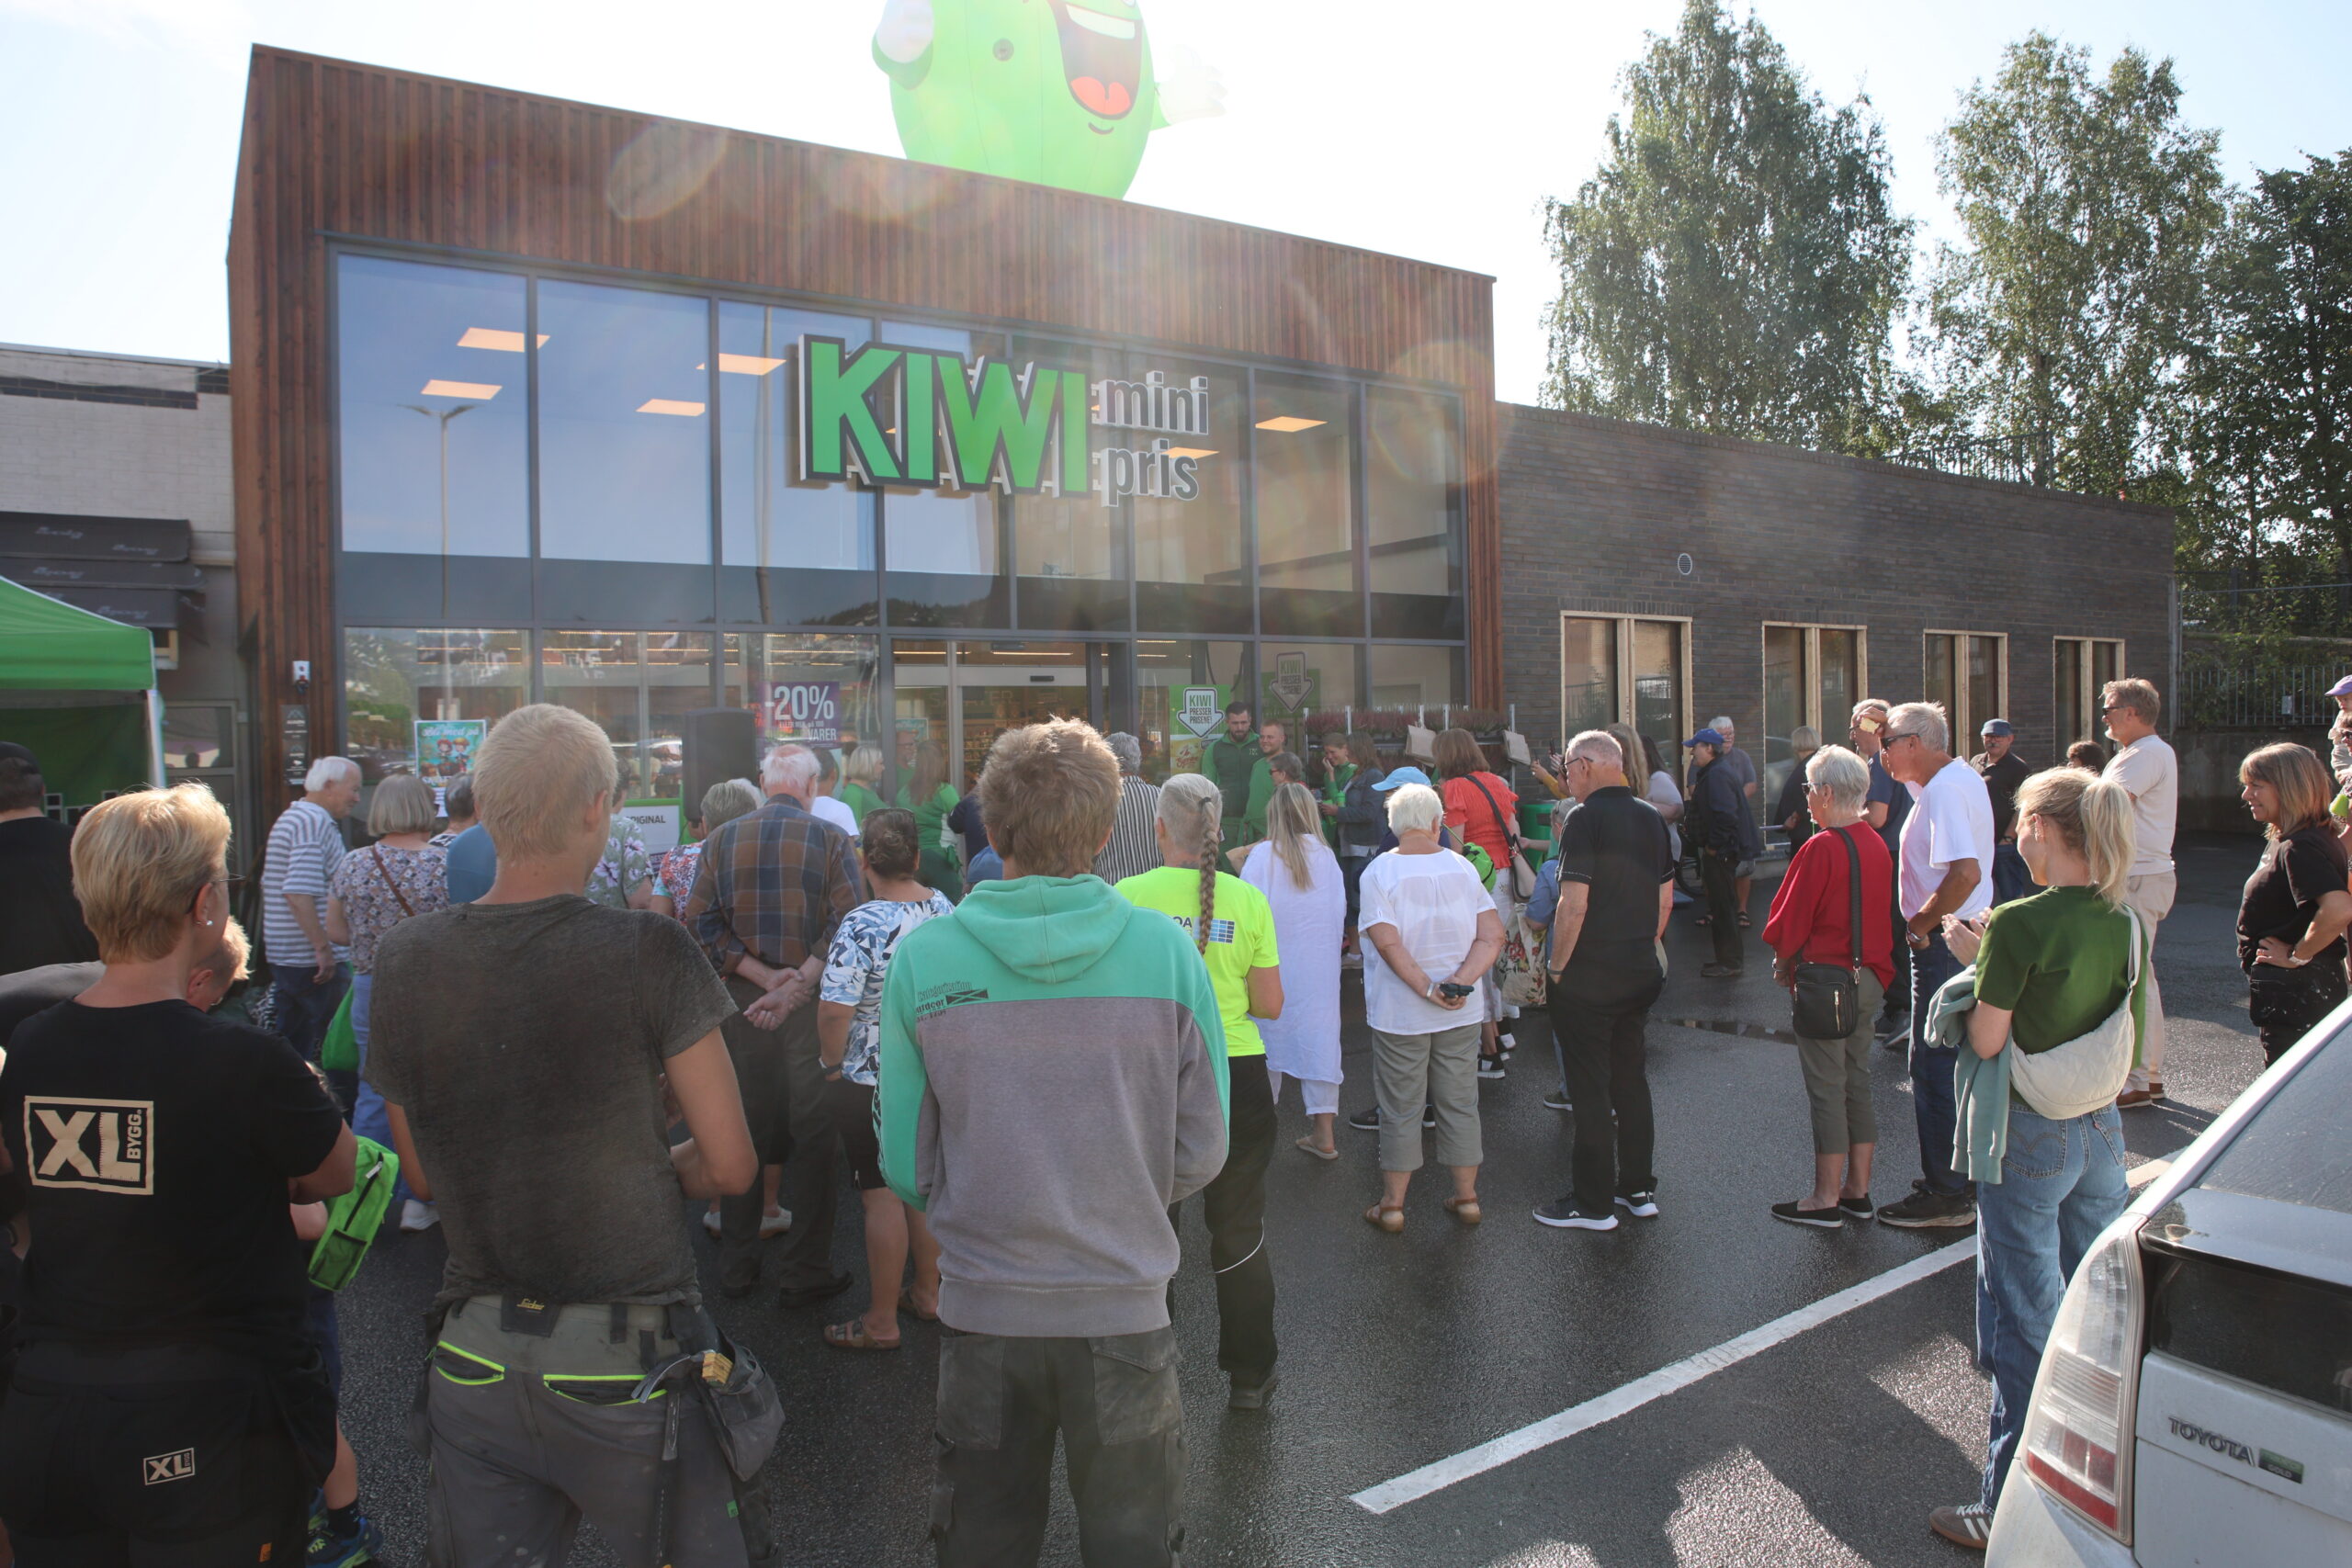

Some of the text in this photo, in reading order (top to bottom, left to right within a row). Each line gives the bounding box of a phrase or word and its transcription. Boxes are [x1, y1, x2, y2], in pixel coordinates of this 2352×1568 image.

[801, 333, 1092, 498] KIWI
[1101, 371, 1208, 434] mini
[1102, 438, 1199, 507] pris
[1281, 660, 1301, 674] KIWI
[764, 685, 834, 720] -20%
[1189, 694, 1212, 707] KIWI
[1189, 707, 1212, 716] PRESSER
[808, 728, 837, 740] VARER
[1189, 716, 1213, 724] PRISENE!
[627, 816, 666, 824] RIGINAL
[34, 1109, 141, 1182] XL
[2168, 1416, 2256, 1468] TOYOTA
[148, 1454, 191, 1482] XL
